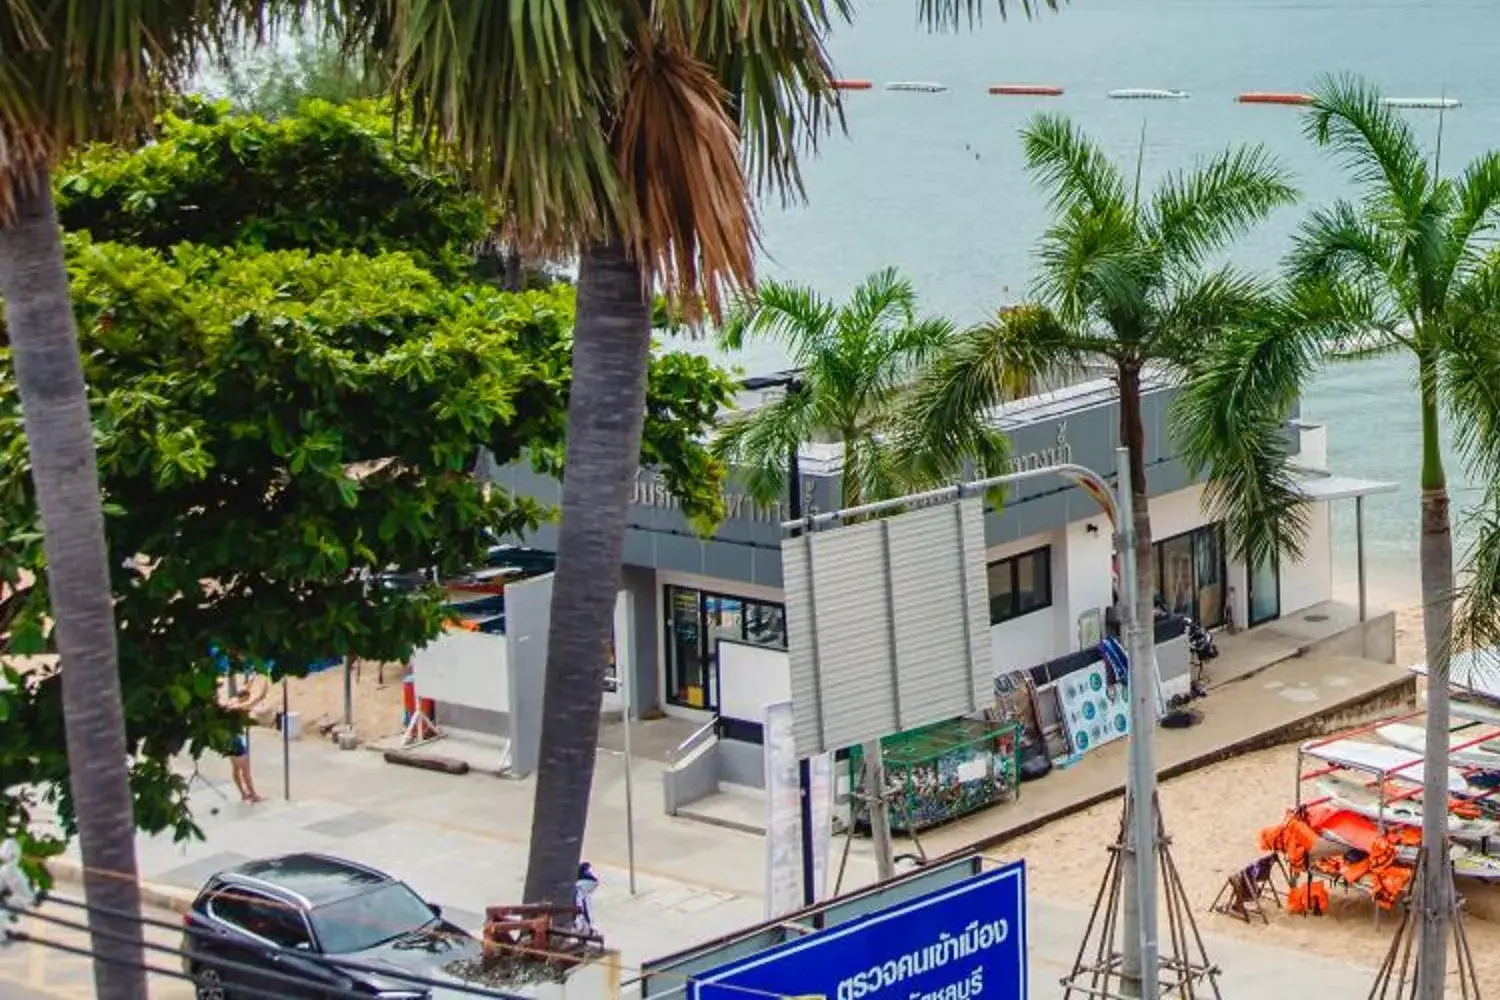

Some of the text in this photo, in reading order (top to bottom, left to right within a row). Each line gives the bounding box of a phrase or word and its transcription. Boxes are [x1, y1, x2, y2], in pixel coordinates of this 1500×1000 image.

[838, 918, 1008, 1000] ตรวจคนเข้าเมือง
